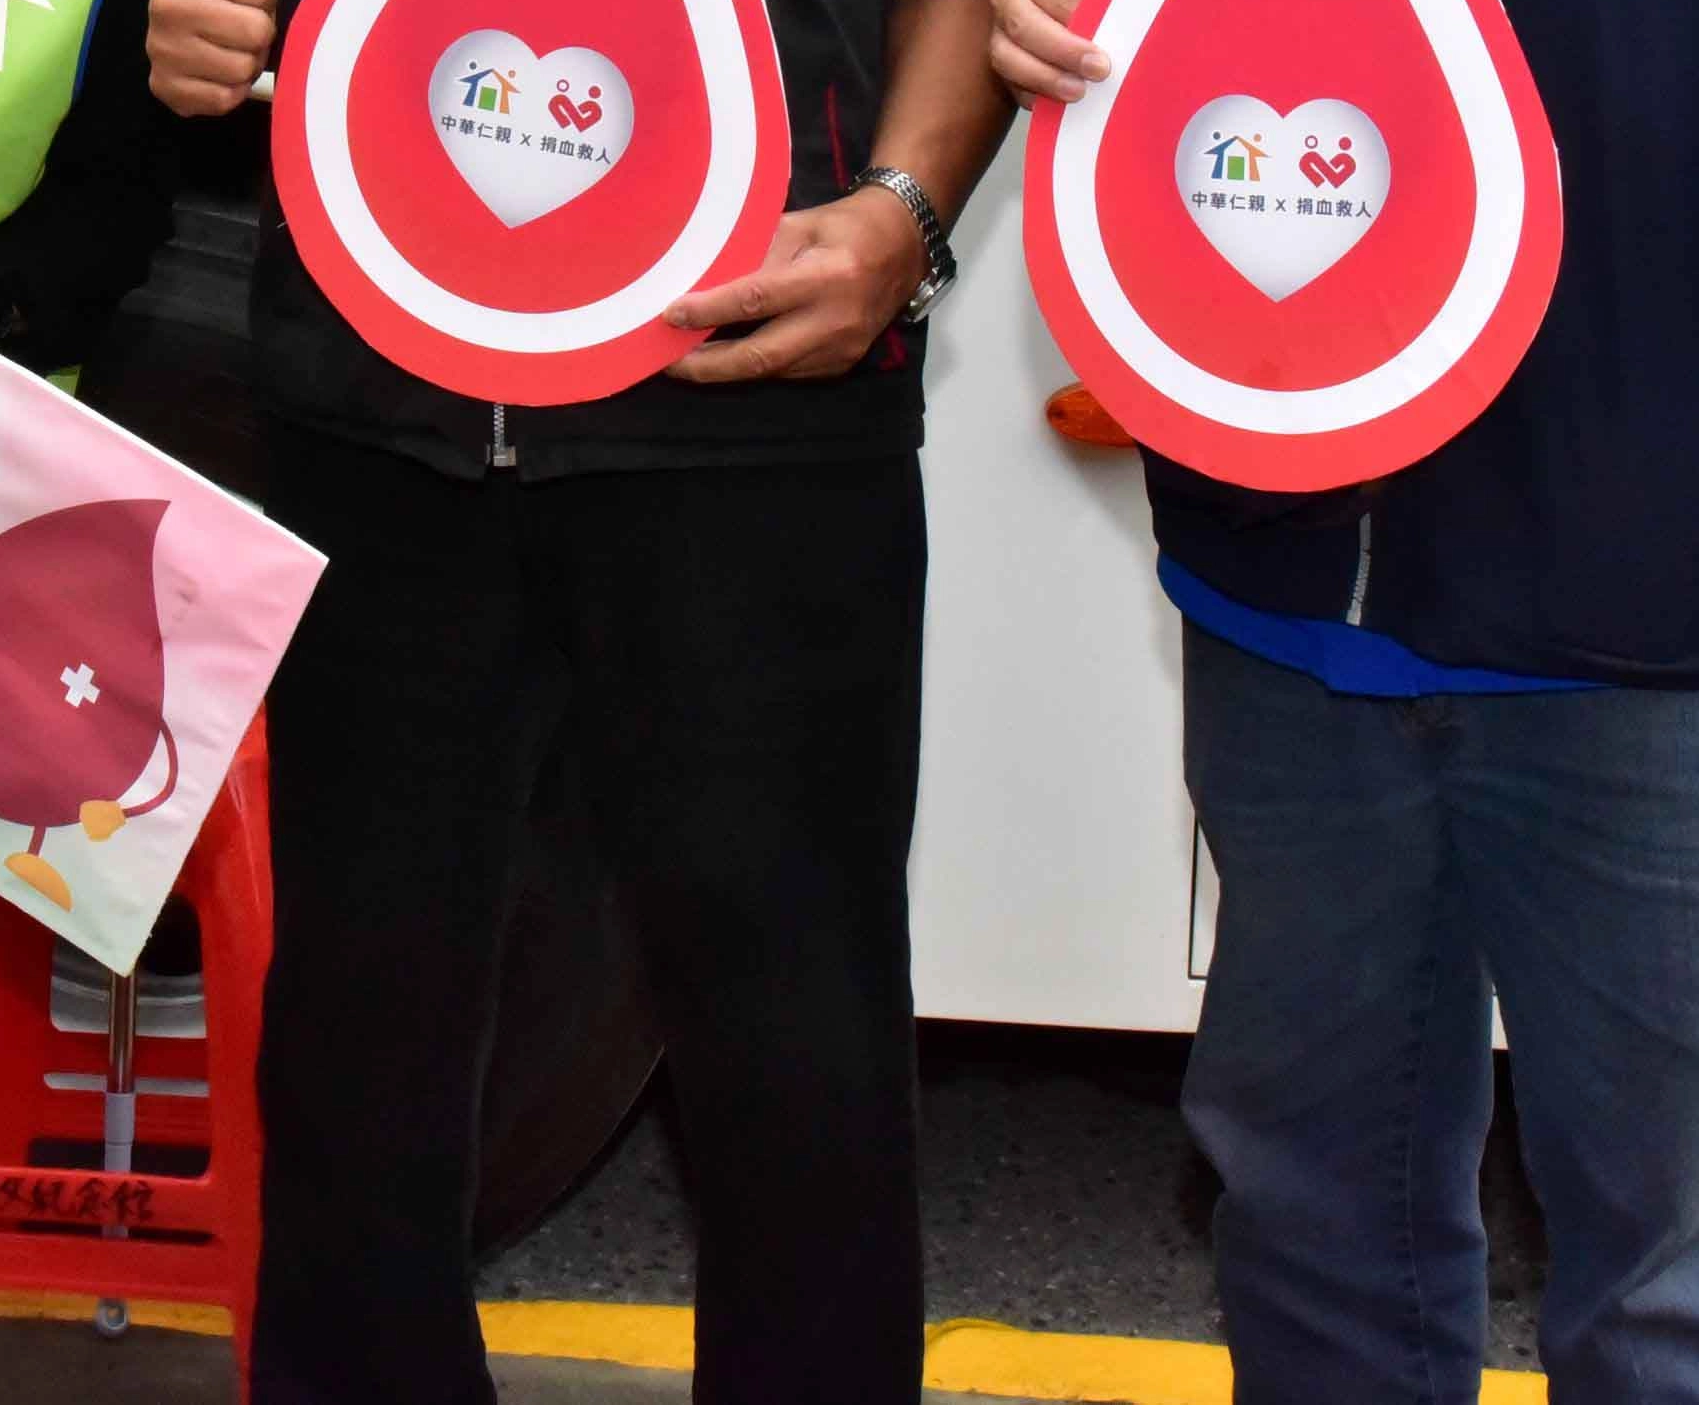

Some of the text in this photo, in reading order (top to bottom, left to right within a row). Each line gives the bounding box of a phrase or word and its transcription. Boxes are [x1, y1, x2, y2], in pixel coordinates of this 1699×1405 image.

[440, 113, 512, 146] 中華仁親
[539, 134, 613, 166] 捐血救人
[1190, 190, 1267, 214] 中華仁親
[1296, 196, 1374, 220] 捐血救人
